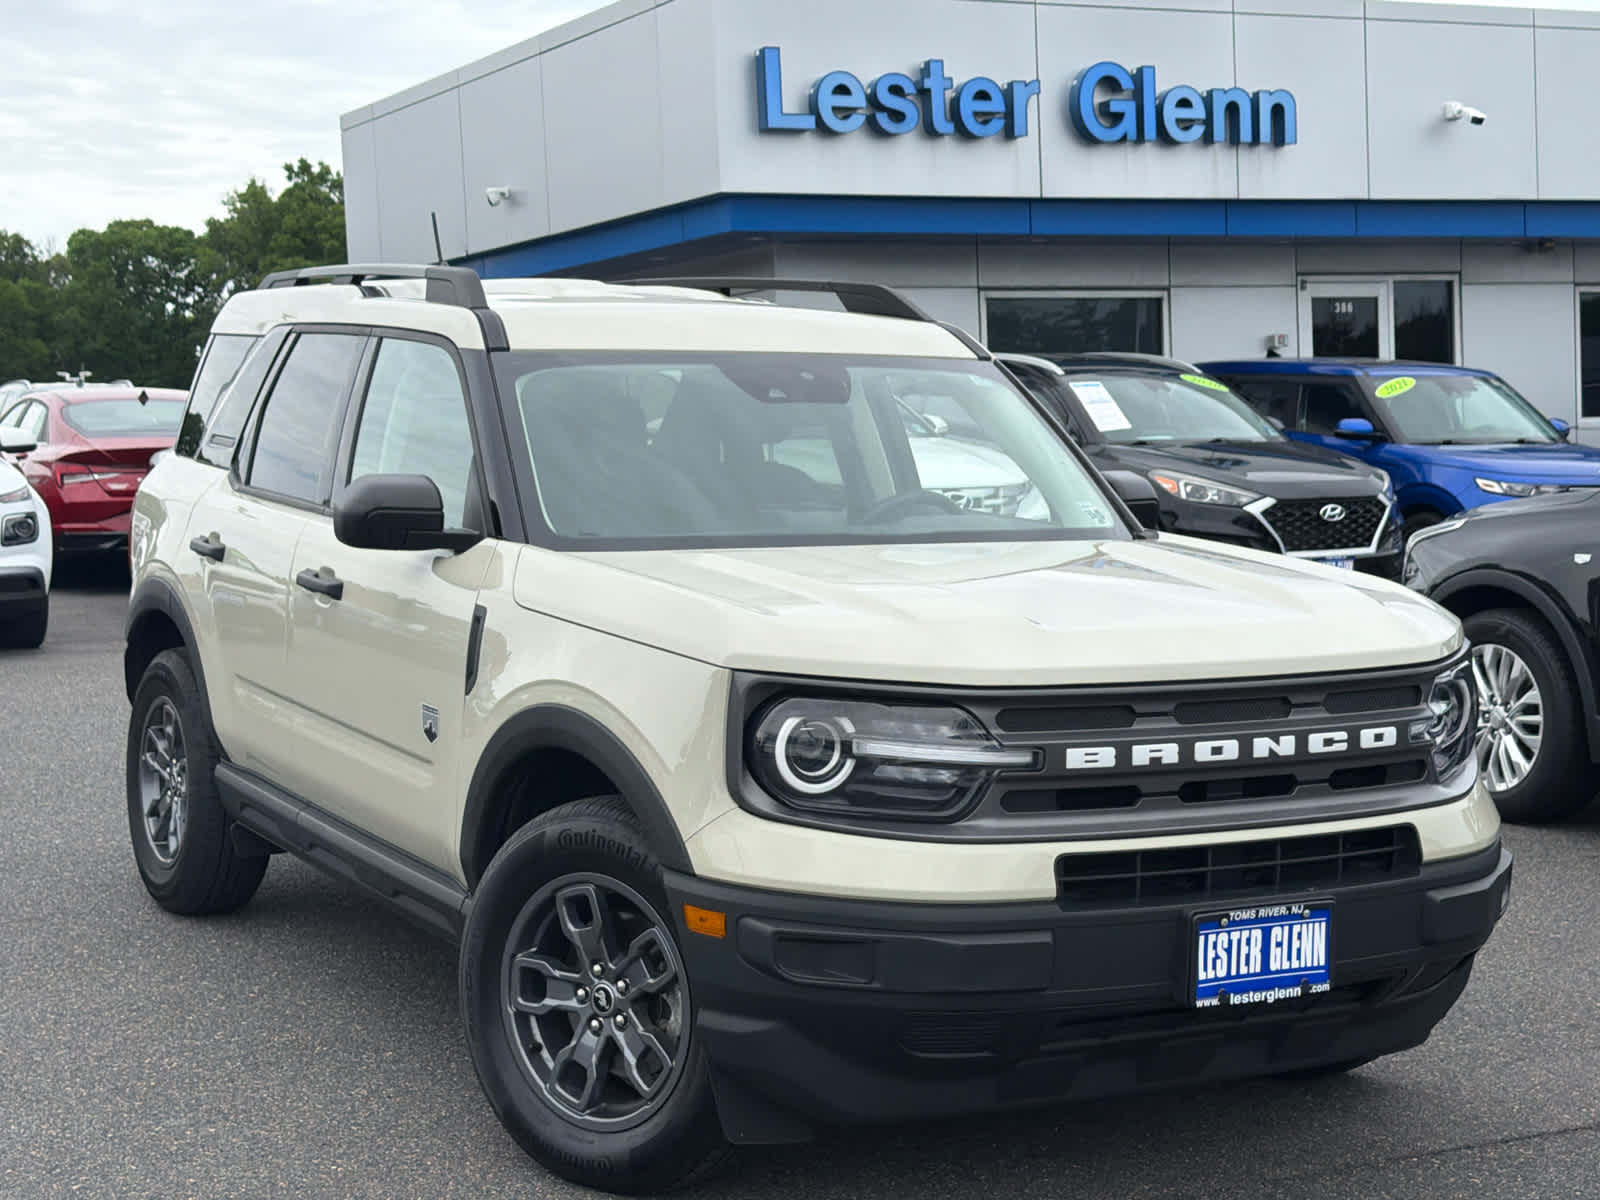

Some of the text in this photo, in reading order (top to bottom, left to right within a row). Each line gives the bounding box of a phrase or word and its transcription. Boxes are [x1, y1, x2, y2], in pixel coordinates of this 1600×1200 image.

[757, 46, 1297, 147] Lester Glenn
[1065, 726, 1397, 769] BRONCO
[558, 828, 649, 868] Continental
[1229, 911, 1256, 921] TOMS
[1291, 905, 1304, 915] NJ
[1198, 923, 1326, 980] LESTER GLENN
[1196, 983, 1330, 1008] www. lesterglenn .com
